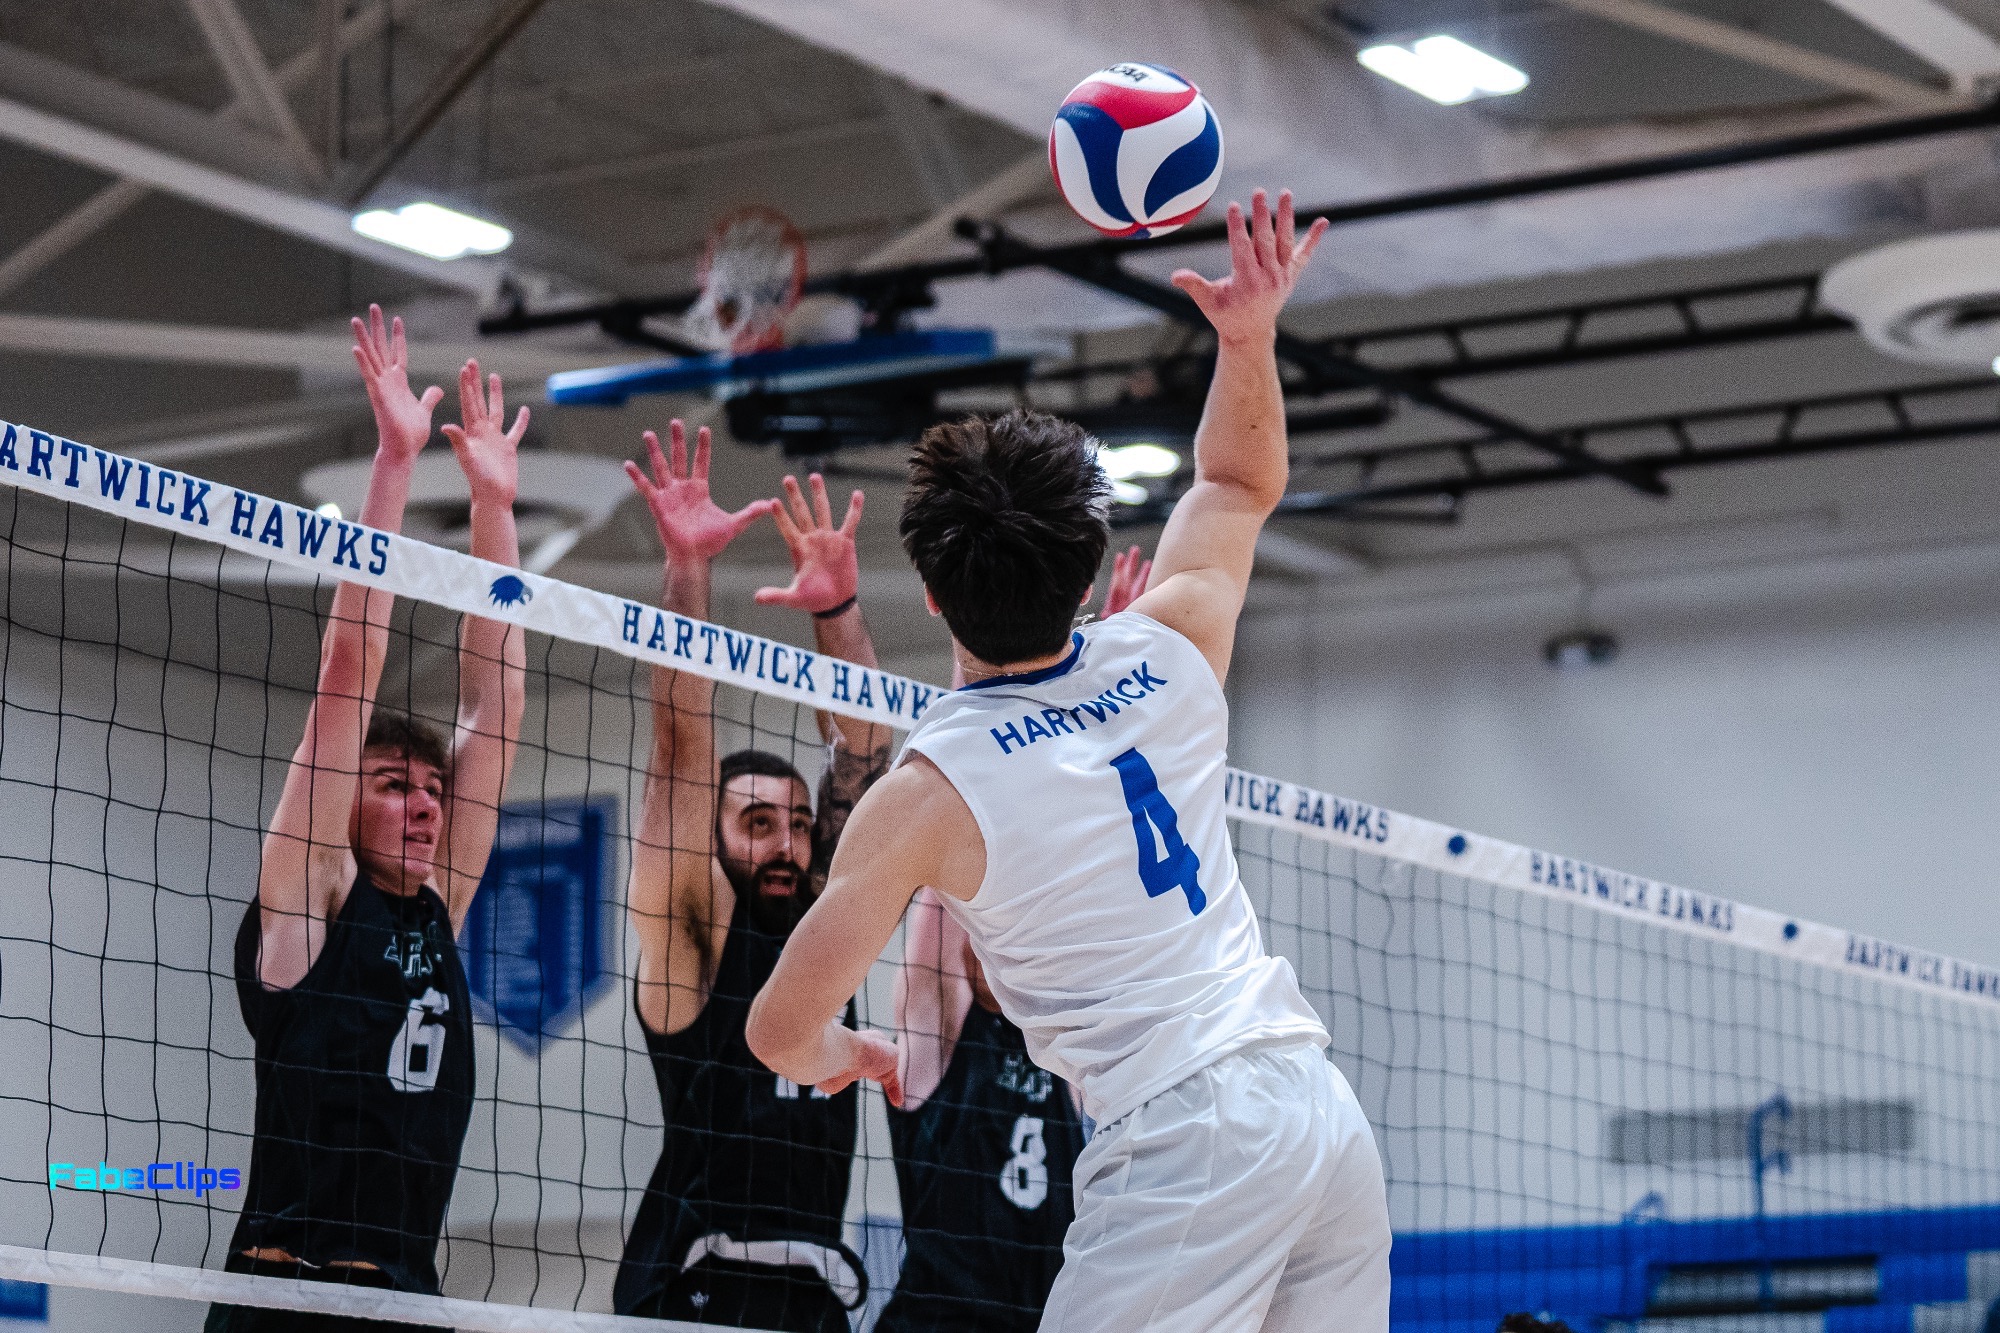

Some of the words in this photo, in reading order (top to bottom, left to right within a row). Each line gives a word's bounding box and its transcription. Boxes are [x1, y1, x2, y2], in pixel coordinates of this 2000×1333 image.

[230, 490, 390, 575] HAWKS
[622, 603, 817, 691] HARTWICK
[831, 663, 948, 720] HAWK
[990, 661, 1168, 754] HARTWICK
[1109, 747, 1207, 916] 4
[1294, 789, 1390, 843] HAWKS
[387, 987, 449, 1092] 6
[999, 1114, 1048, 1210] 8
